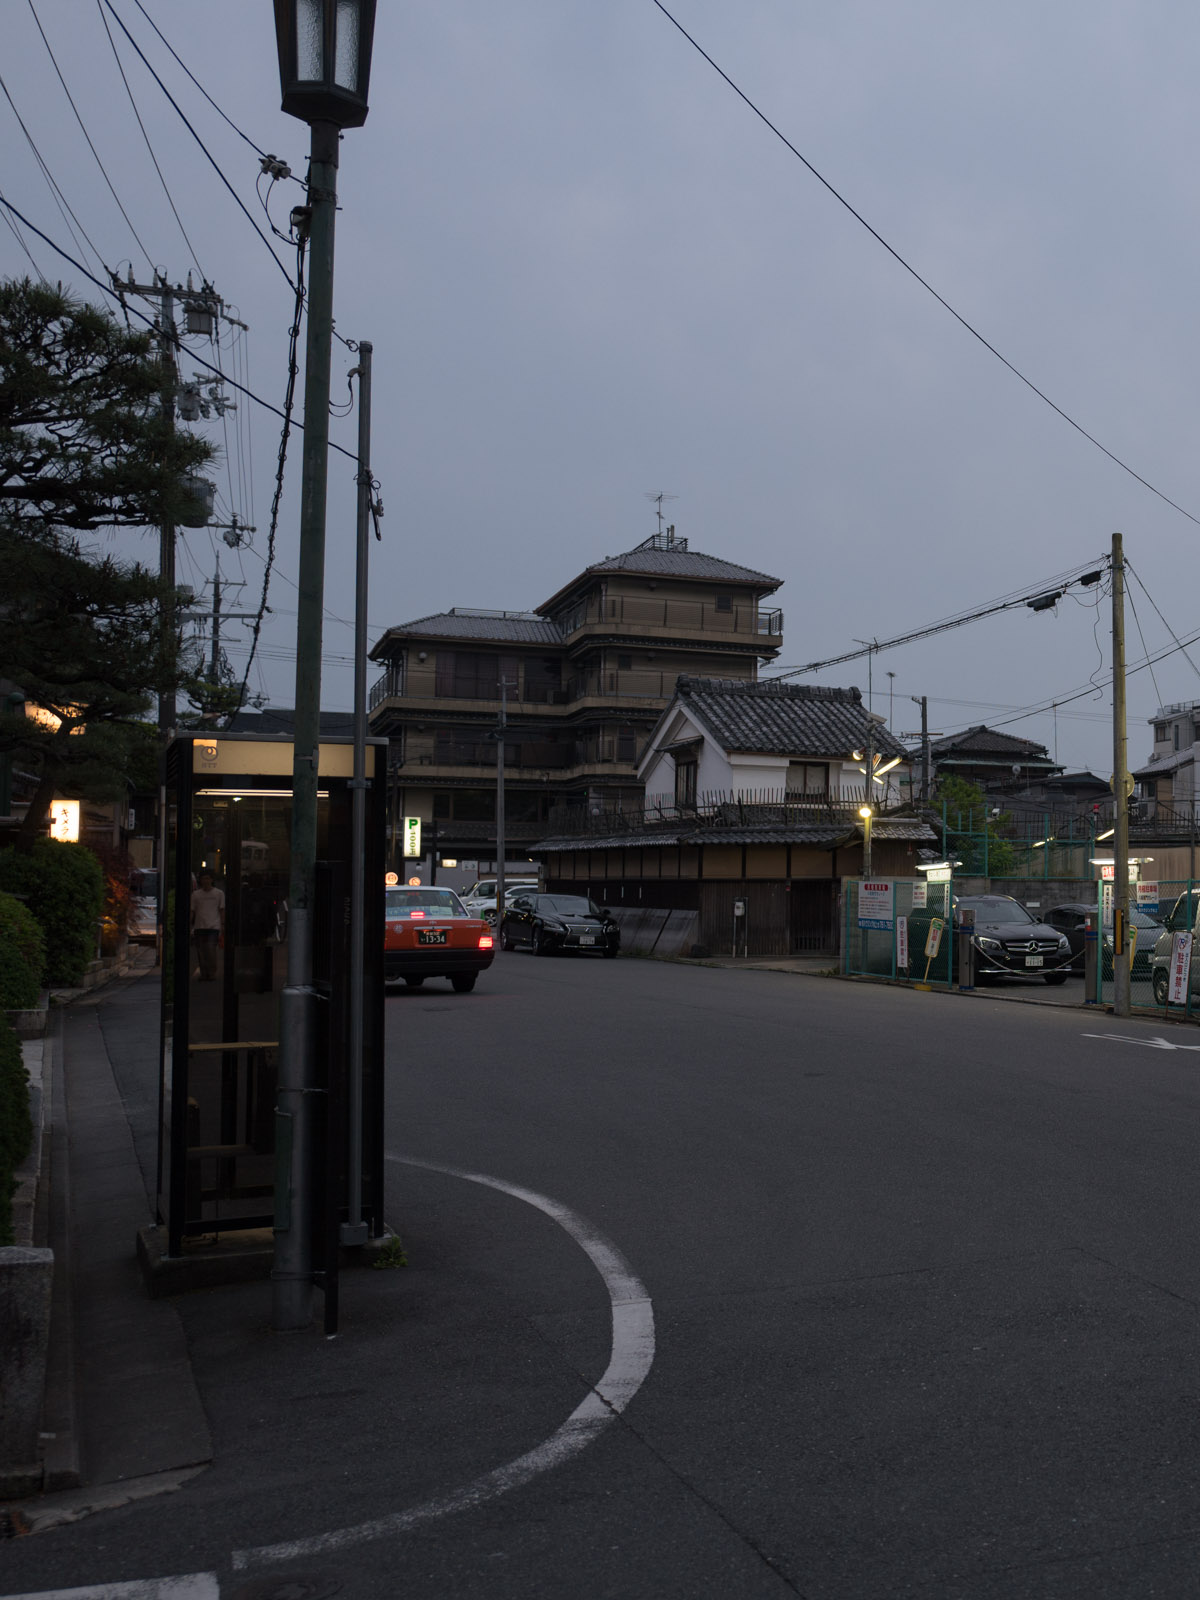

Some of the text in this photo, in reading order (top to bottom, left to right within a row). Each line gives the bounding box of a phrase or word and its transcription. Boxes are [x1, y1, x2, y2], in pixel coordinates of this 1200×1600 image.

[61, 808, 70, 835] キメラ
[409, 819, 418, 829] P
